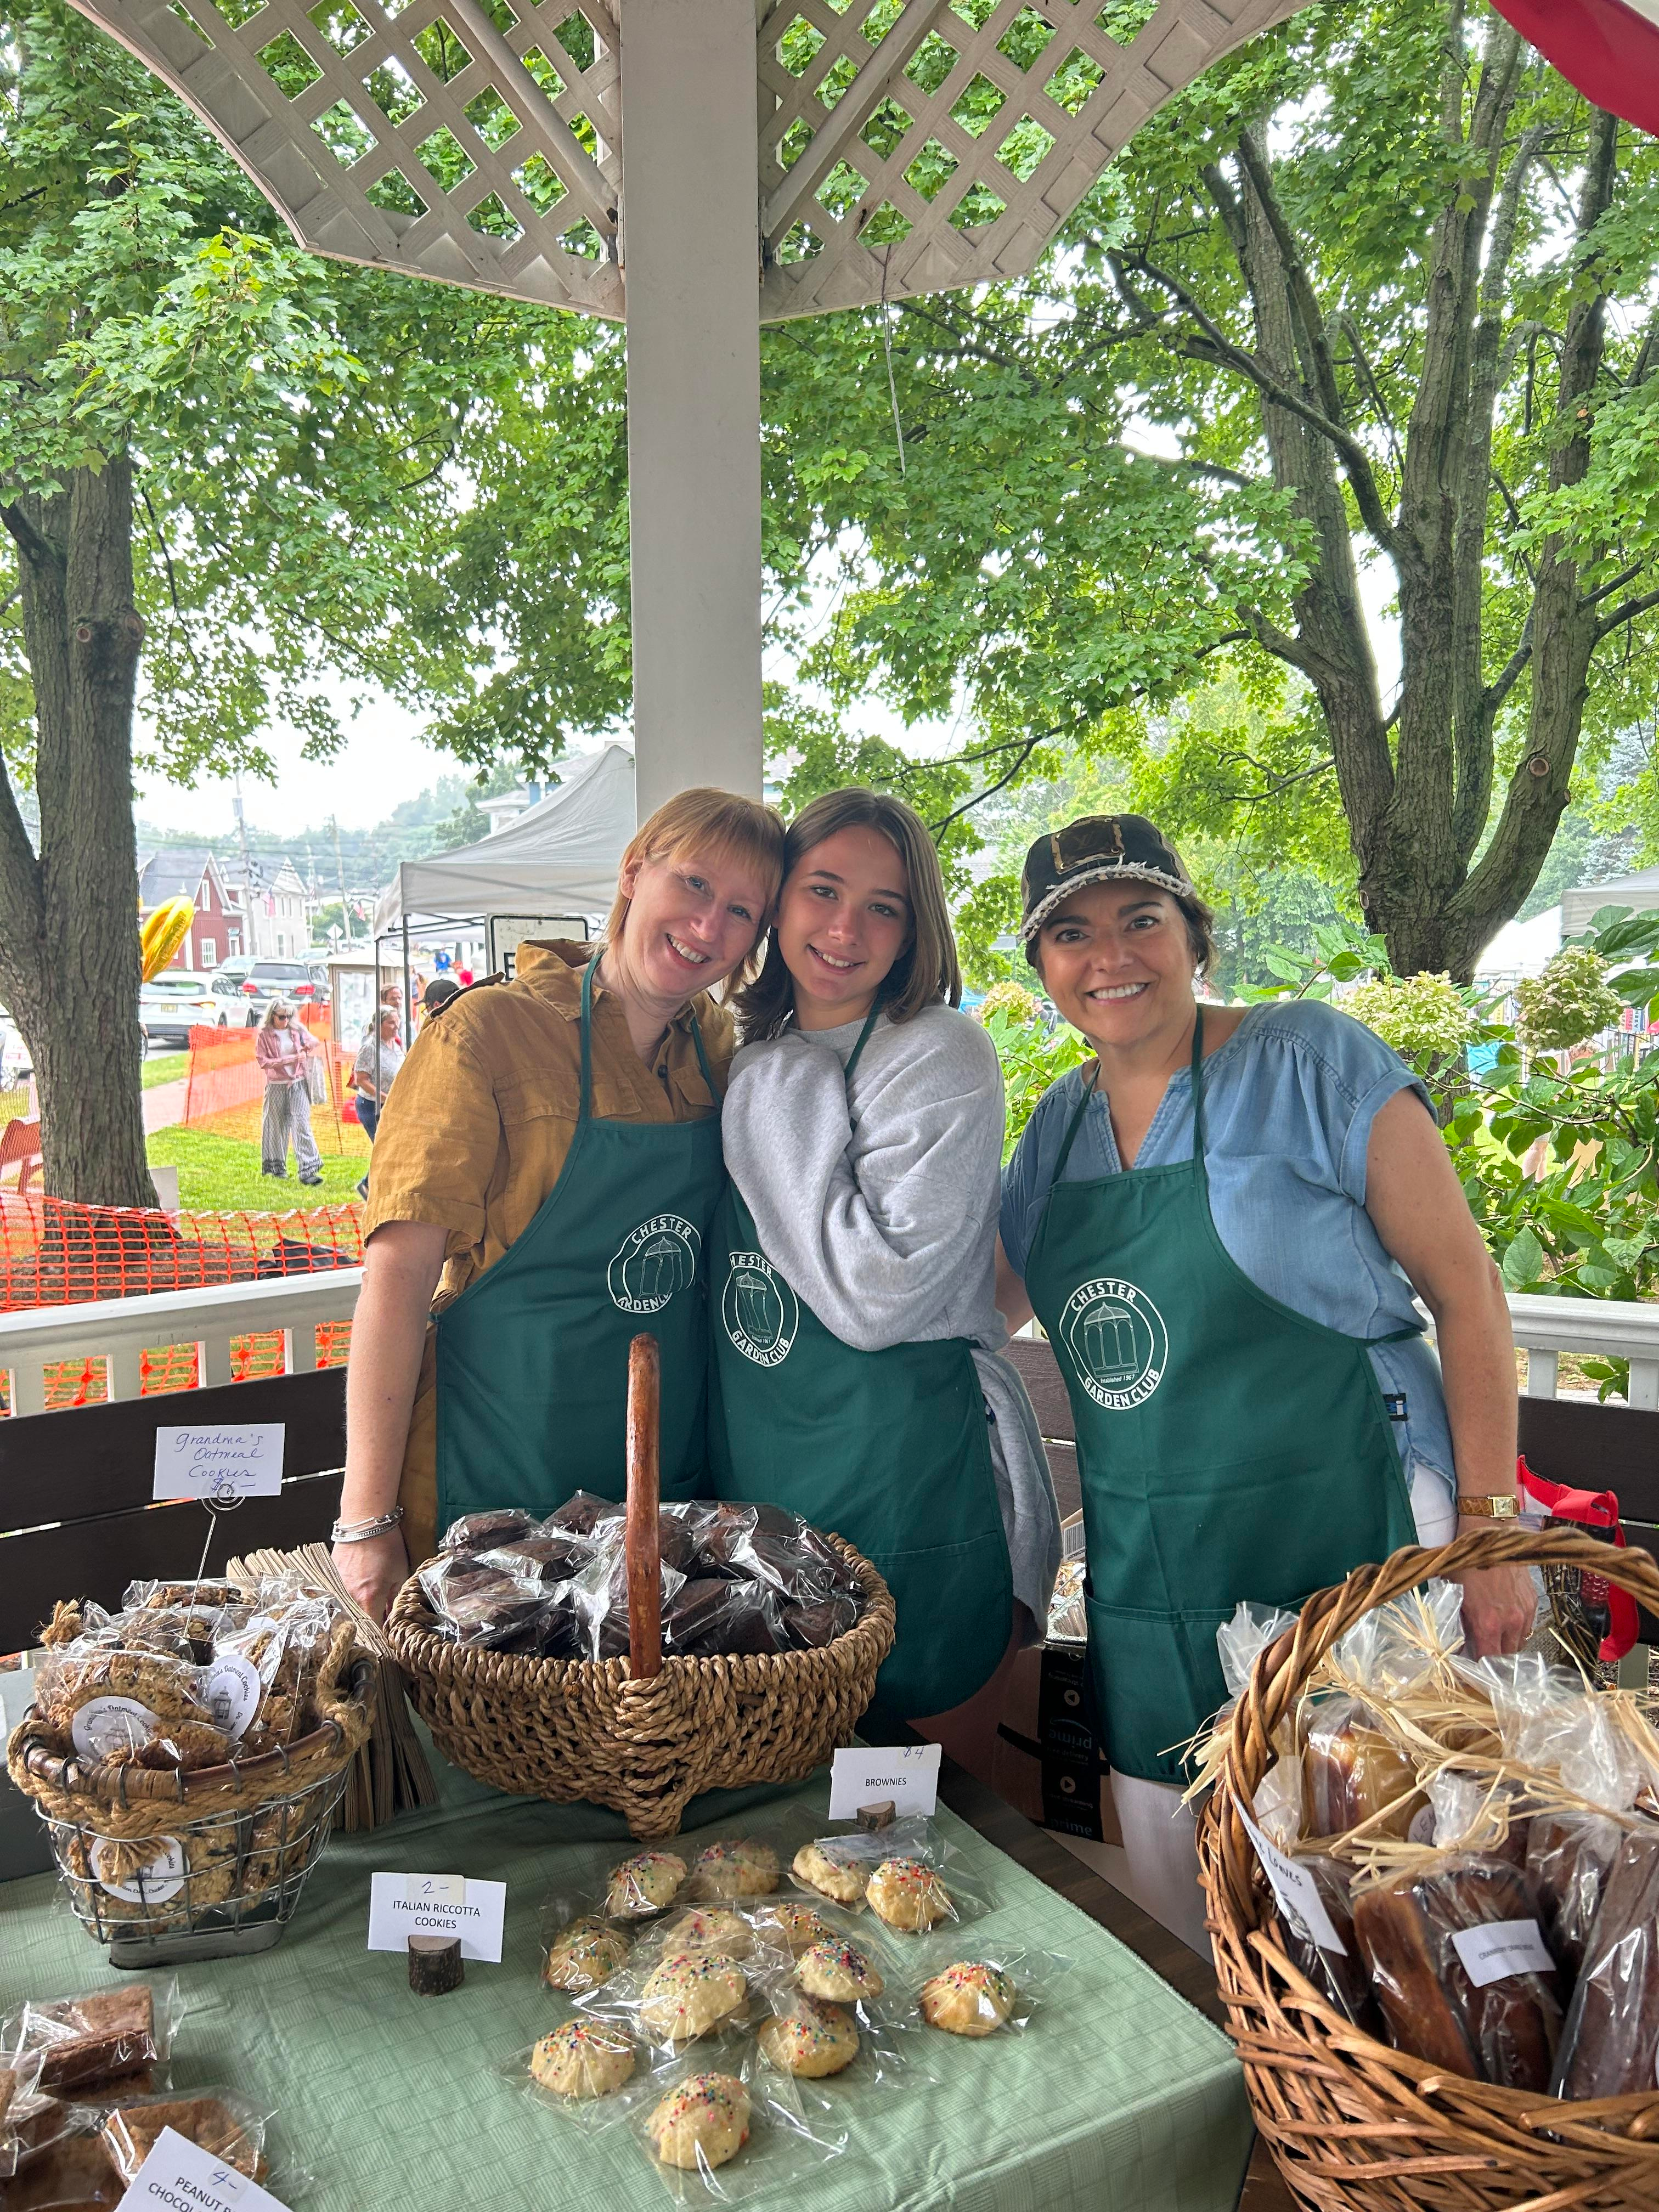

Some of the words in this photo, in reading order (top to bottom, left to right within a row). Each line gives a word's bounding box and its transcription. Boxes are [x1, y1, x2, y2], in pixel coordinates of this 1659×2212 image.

[631, 1217, 692, 1244] CHESTER
[729, 1255, 772, 1277] HESTER
[1070, 1282, 1137, 1312] CHESTER
[769, 1338, 790, 1362] CLUB
[1084, 1376, 1131, 1407] GARDEN
[1131, 1369, 1160, 1402] CLUB
[194, 1447, 264, 1461] Oatmeal
[865, 1778, 907, 1787] BROWNIES
[393, 1901, 430, 1912] ITALIAN
[433, 1904, 481, 1917] RICCOTTA
[415, 1917, 456, 1929] COOKIES
[175, 2176, 223, 2211] PEANUT
